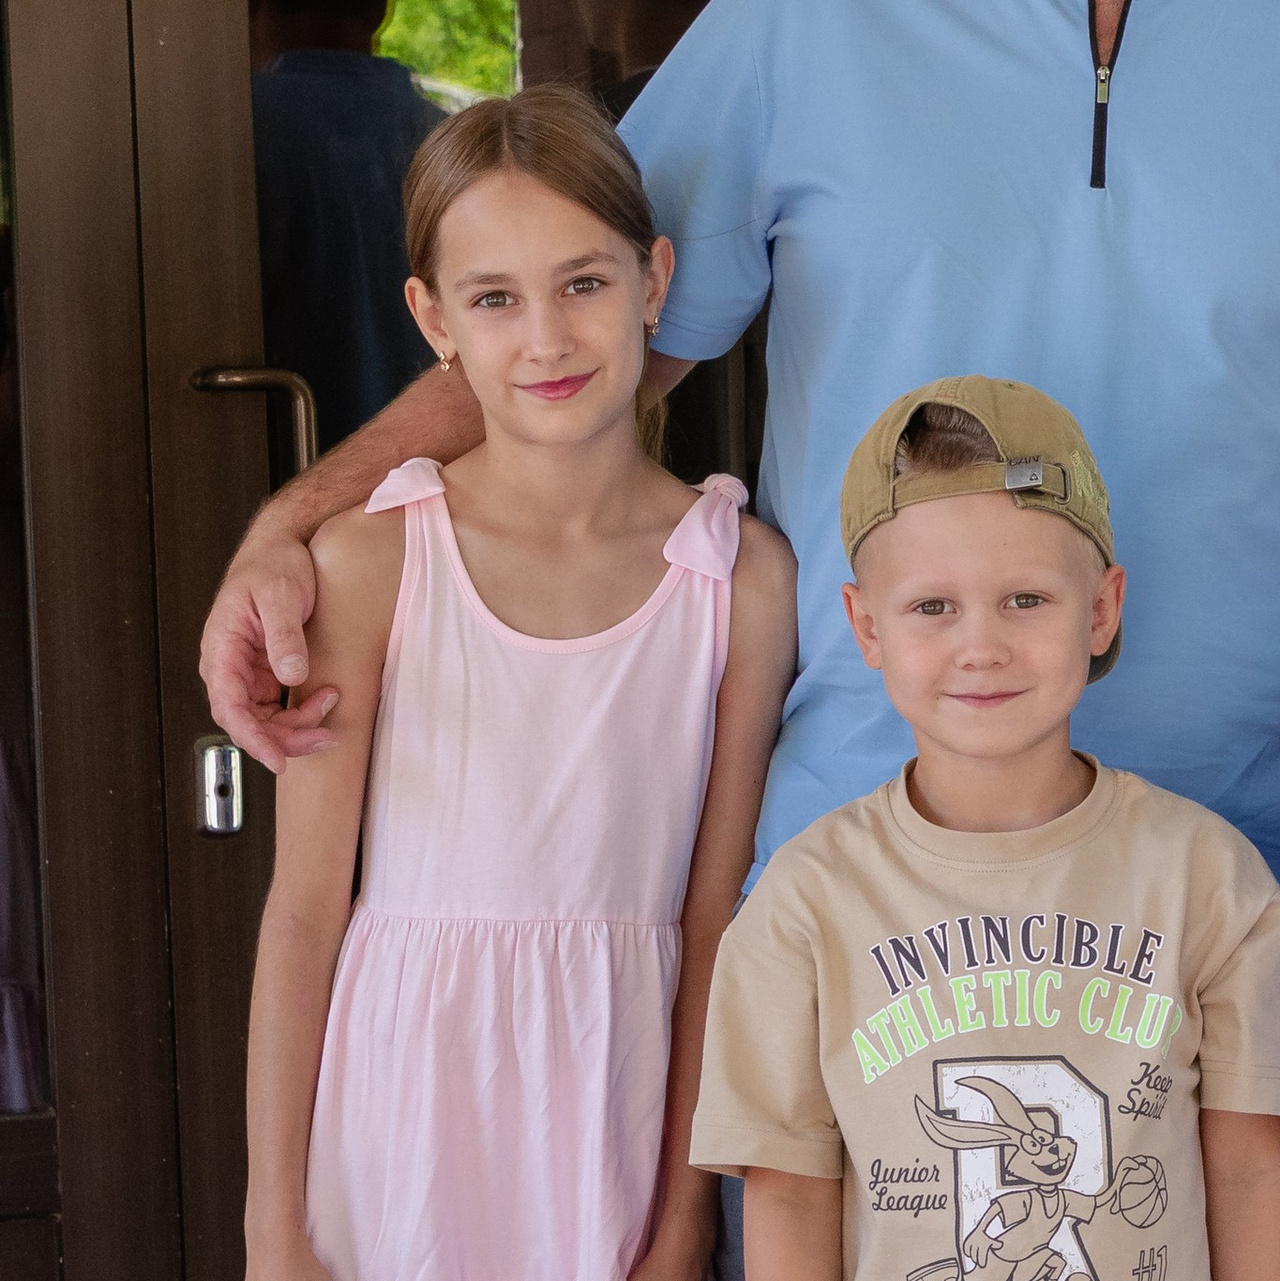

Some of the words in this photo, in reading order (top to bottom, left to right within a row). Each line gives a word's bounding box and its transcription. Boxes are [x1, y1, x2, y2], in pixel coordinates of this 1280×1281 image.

[869, 913, 1165, 997] INVINCIBLE
[851, 970, 1062, 1084] ATHLETIC
[869, 1158, 940, 1191] Junior
[872, 1186, 948, 1218] League
